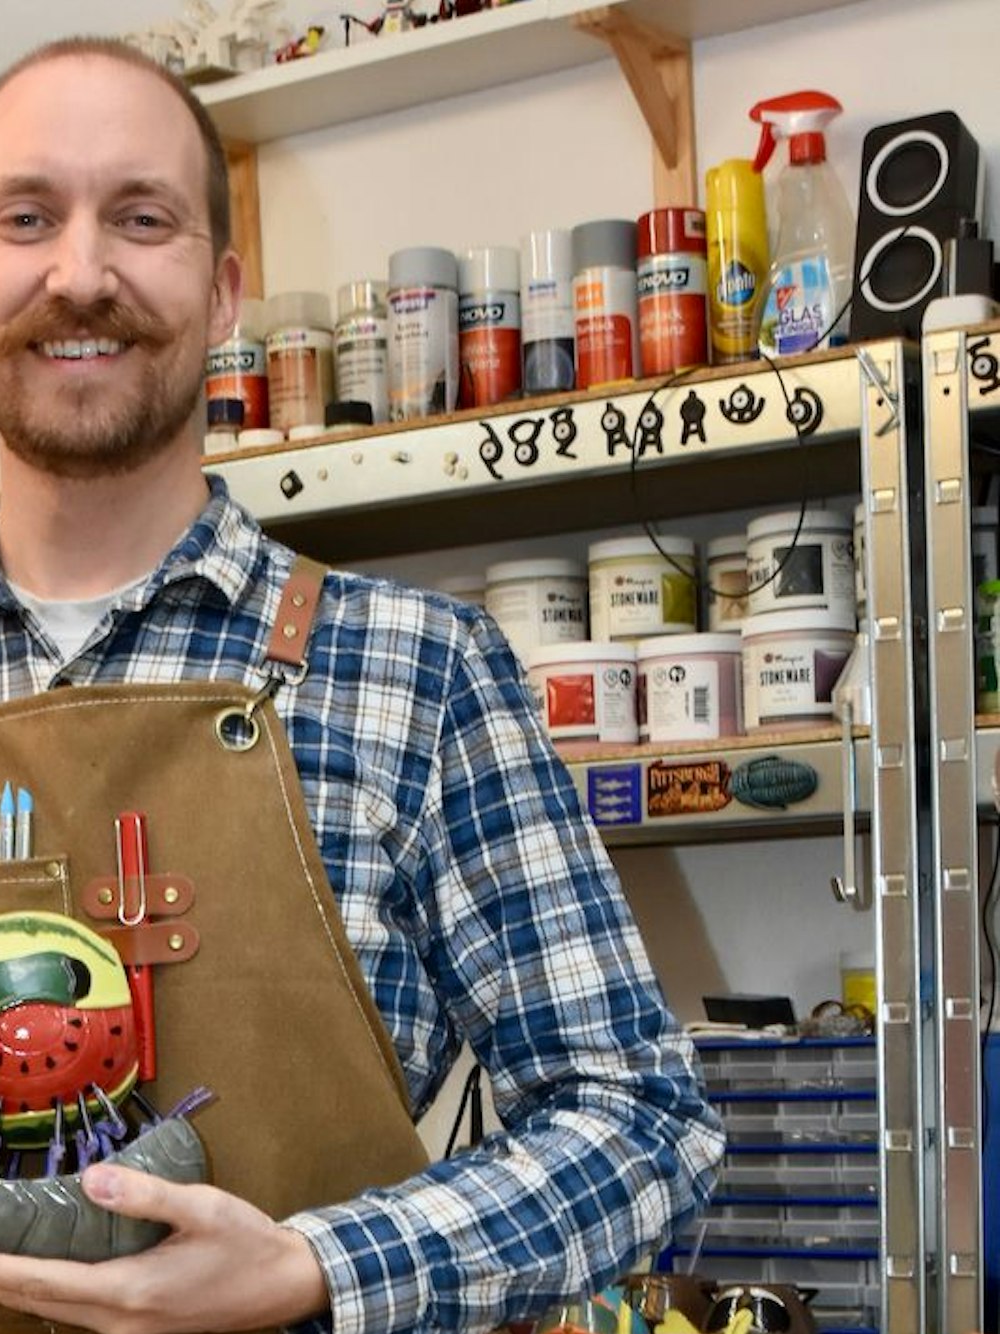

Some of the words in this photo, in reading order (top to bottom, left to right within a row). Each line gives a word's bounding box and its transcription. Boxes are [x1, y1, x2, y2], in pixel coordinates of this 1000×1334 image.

[779, 304, 823, 326] GLAS
[610, 590, 659, 607] STONEWARE
[760, 668, 810, 686] STONEWARE
